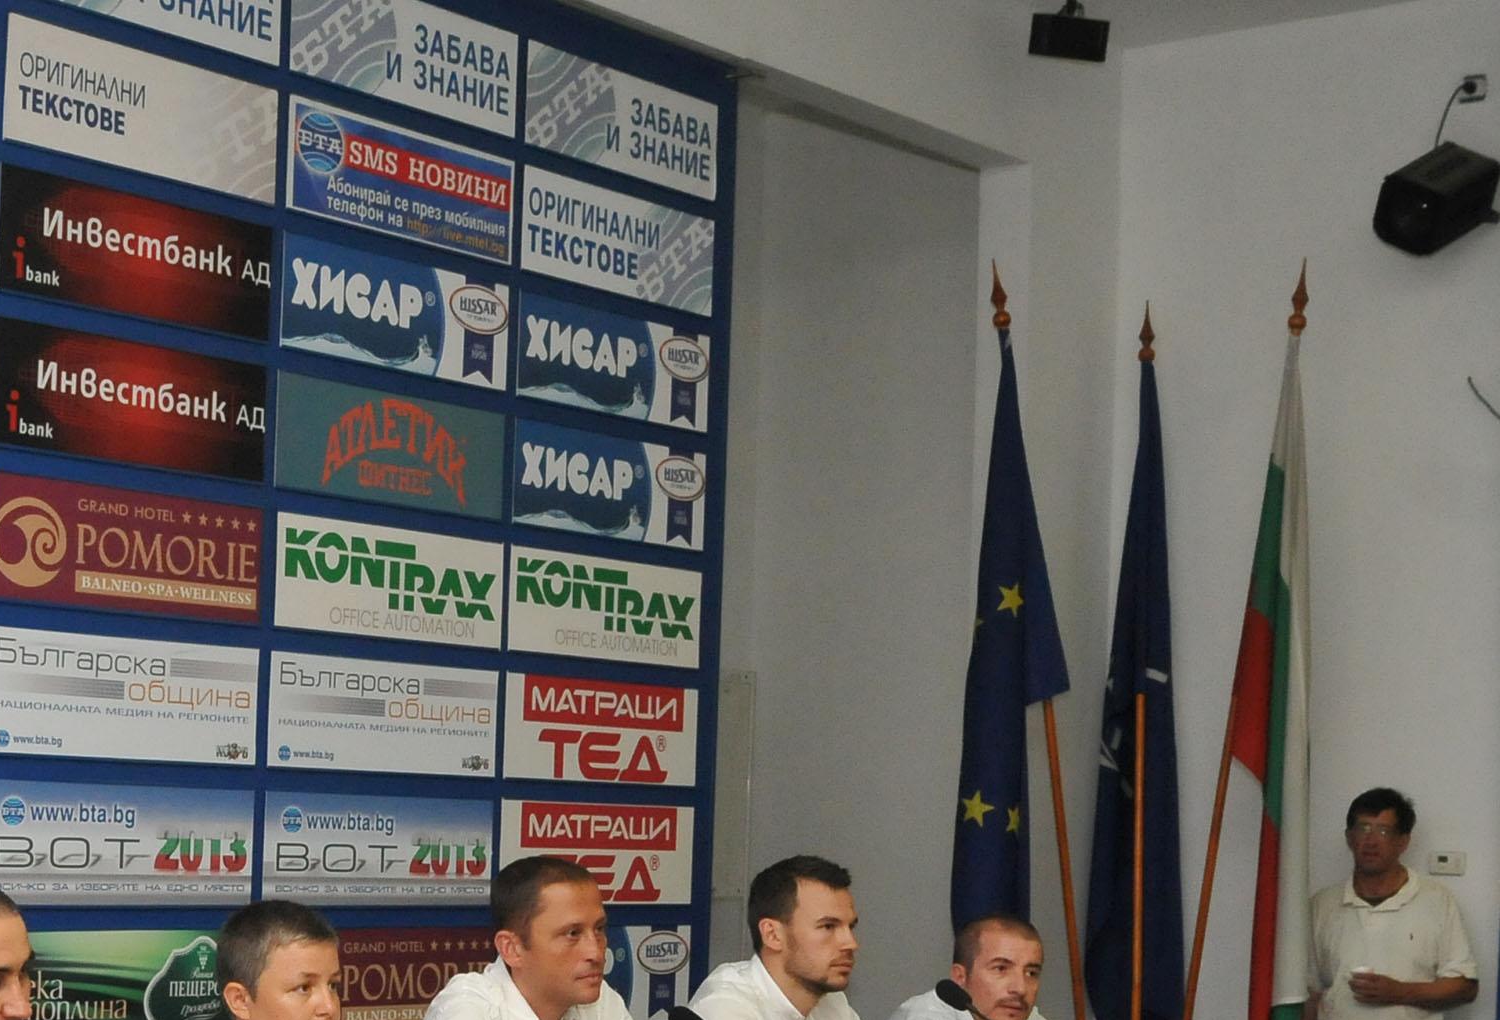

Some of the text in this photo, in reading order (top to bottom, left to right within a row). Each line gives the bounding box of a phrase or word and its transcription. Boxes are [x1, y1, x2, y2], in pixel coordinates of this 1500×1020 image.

[414, 23, 511, 82] ЗАБАВА
[19, 51, 146, 110] ОРИГИНАЛНИ
[386, 51, 509, 117] И ЗНАНИЕ
[18, 85, 126, 136] ТЕКСТОВЕ
[630, 97, 712, 150] ЗАБАВА
[350, 140, 507, 206] SMS НОВИНИ
[606, 122, 710, 182] И ЗНАНИЕ
[326, 194, 385, 223] телефон
[528, 186, 661, 251] ОРИГИНАЛНИ
[43, 206, 272, 289] Инвестбанк АД
[527, 223, 639, 281] ТЕКСТОВЕ
[25, 264, 60, 288] bank
[291, 257, 424, 329] ХИСАР
[525, 314, 638, 379] ХИСАР
[36, 358, 266, 434] Инвестбанк АД
[18, 416, 54, 440] bank
[520, 441, 634, 501] ХИСАР
[78, 498, 176, 524] GRAND HOTEL
[75, 522, 259, 584] POMORIE
[284, 527, 496, 622] KONTRAX
[329, 605, 476, 639] OFFICE AUTOMATION
[516, 556, 695, 641] KONTRAX
[127, 680, 252, 711] община
[279, 660, 421, 697] Българска
[531, 685, 678, 723] МАТРАЦИ
[388, 698, 492, 726] община
[538, 728, 668, 784] ТЕД
[30, 802, 136, 829] www.bta.bg
[306, 812, 395, 835] www.bta.bg
[528, 812, 671, 842] МАТРАЦИ
[153, 830, 248, 874] 2013
[408, 836, 488, 876] 2013
[344, 940, 426, 955] GRAND HOTEL
